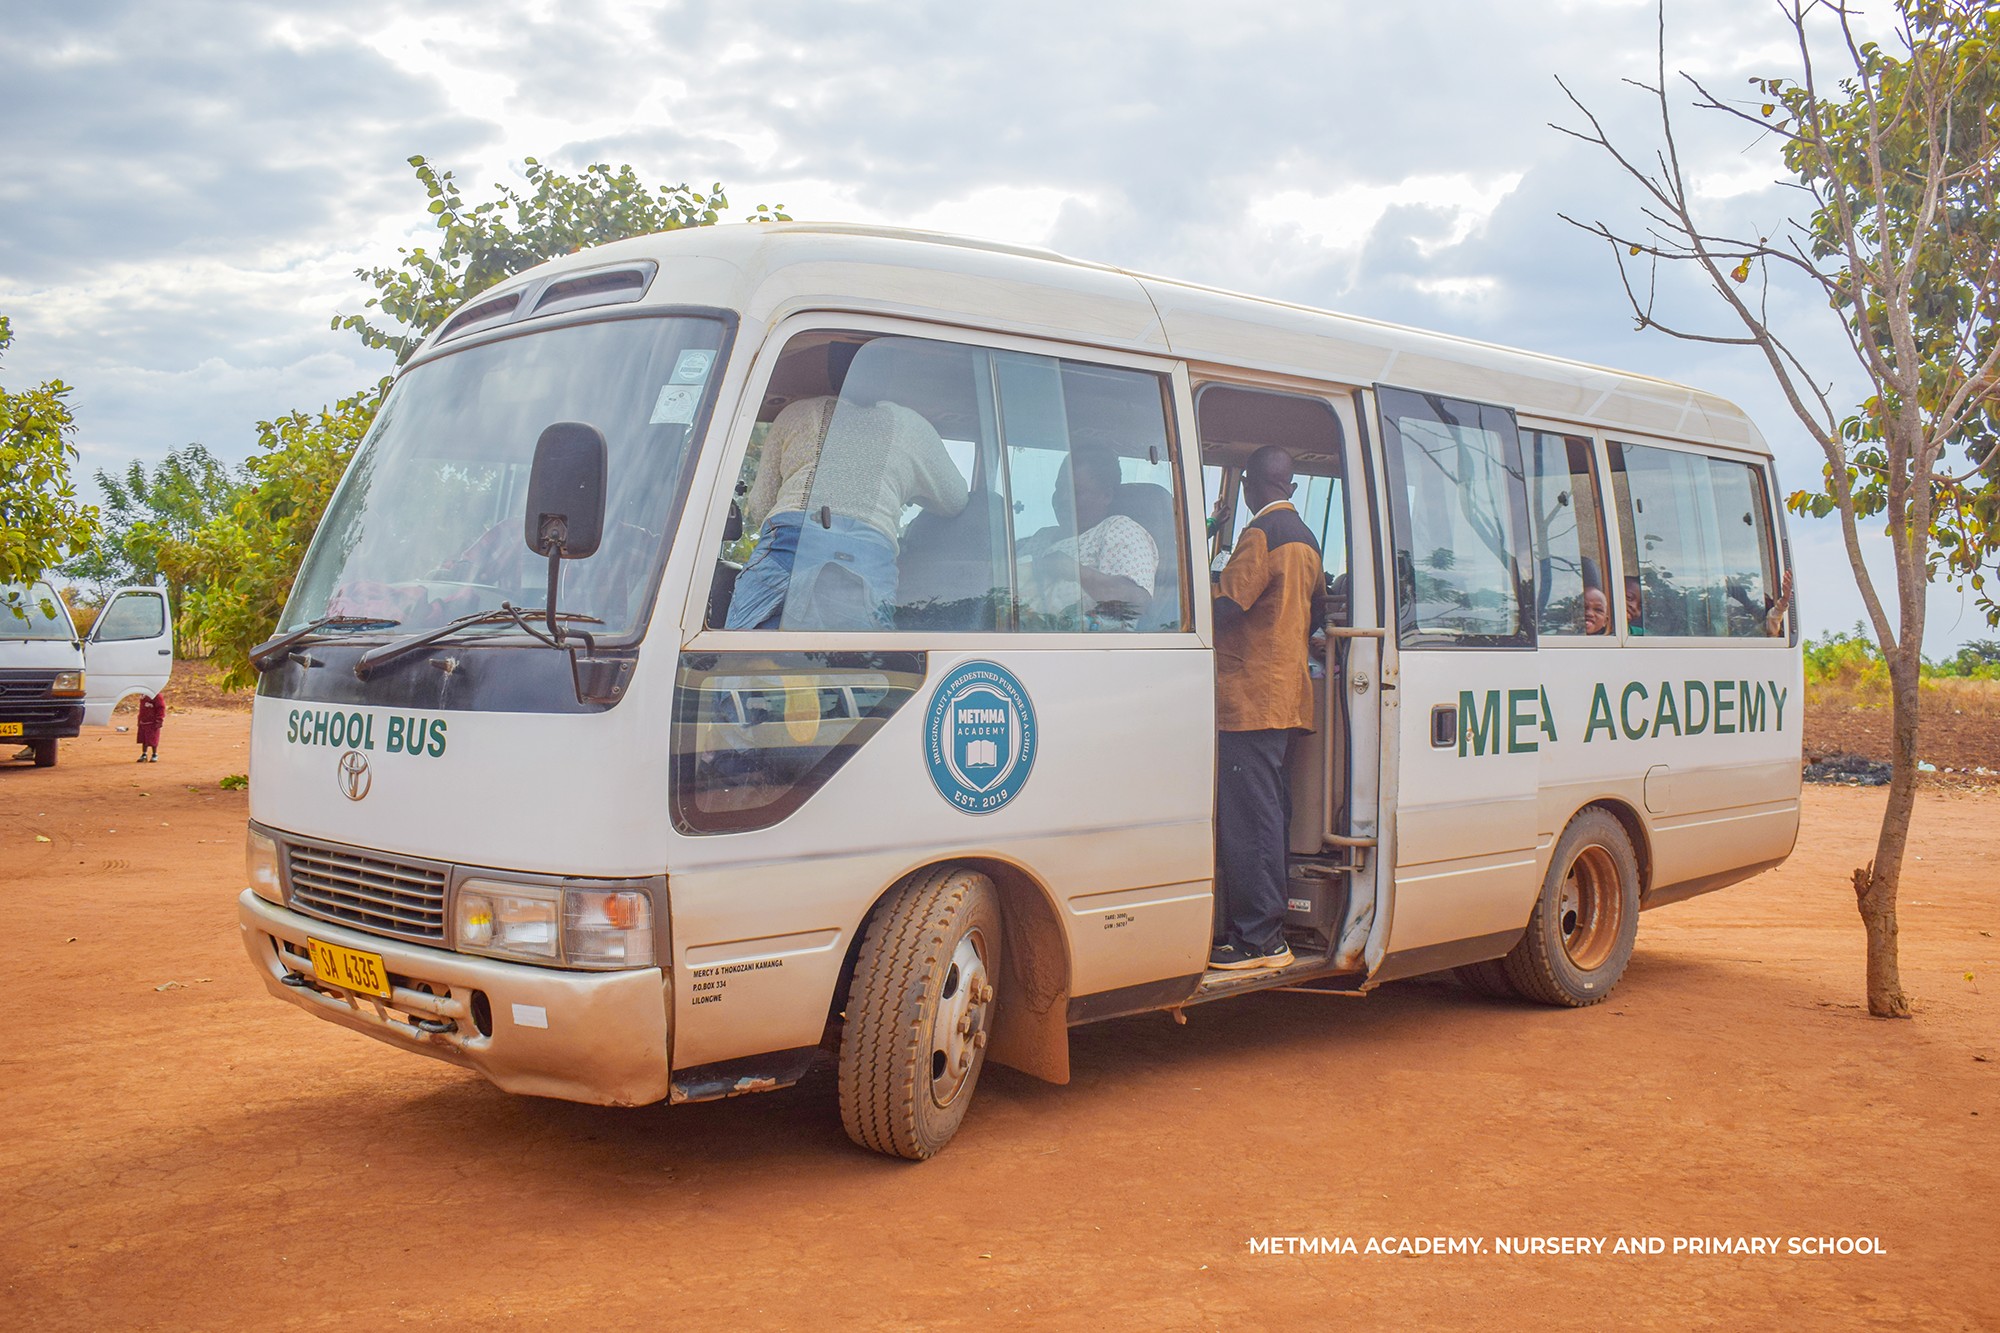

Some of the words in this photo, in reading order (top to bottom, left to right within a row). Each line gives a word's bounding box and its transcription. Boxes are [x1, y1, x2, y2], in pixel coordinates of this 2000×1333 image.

[950, 670, 999, 693] PREDESTINED
[936, 694, 948, 714] OUT
[999, 677, 1025, 711] PURPOSE
[958, 708, 1006, 724] METMMA
[1021, 711, 1028, 721] IN
[1583, 680, 1788, 743] ACADEMY
[0, 724, 18, 735] 415
[287, 709, 374, 750] SCHOOL
[387, 715, 447, 758] BUS
[957, 727, 1006, 736] ACADEMY
[931, 716, 941, 765] BRINGING
[1021, 731, 1031, 762] CHILD
[954, 790, 978, 808] EST.
[982, 788, 1008, 808] 2019
[321, 946, 340, 980] SA
[343, 953, 380, 990] 4335
[693, 968, 714, 978] MERCY
[715, 967, 720, 976] &
[721, 965, 755, 975] THOKOZANI
[755, 959, 784, 970] KAMANGA
[716, 980, 727, 989] 334
[692, 993, 722, 1005] LILONGWE
